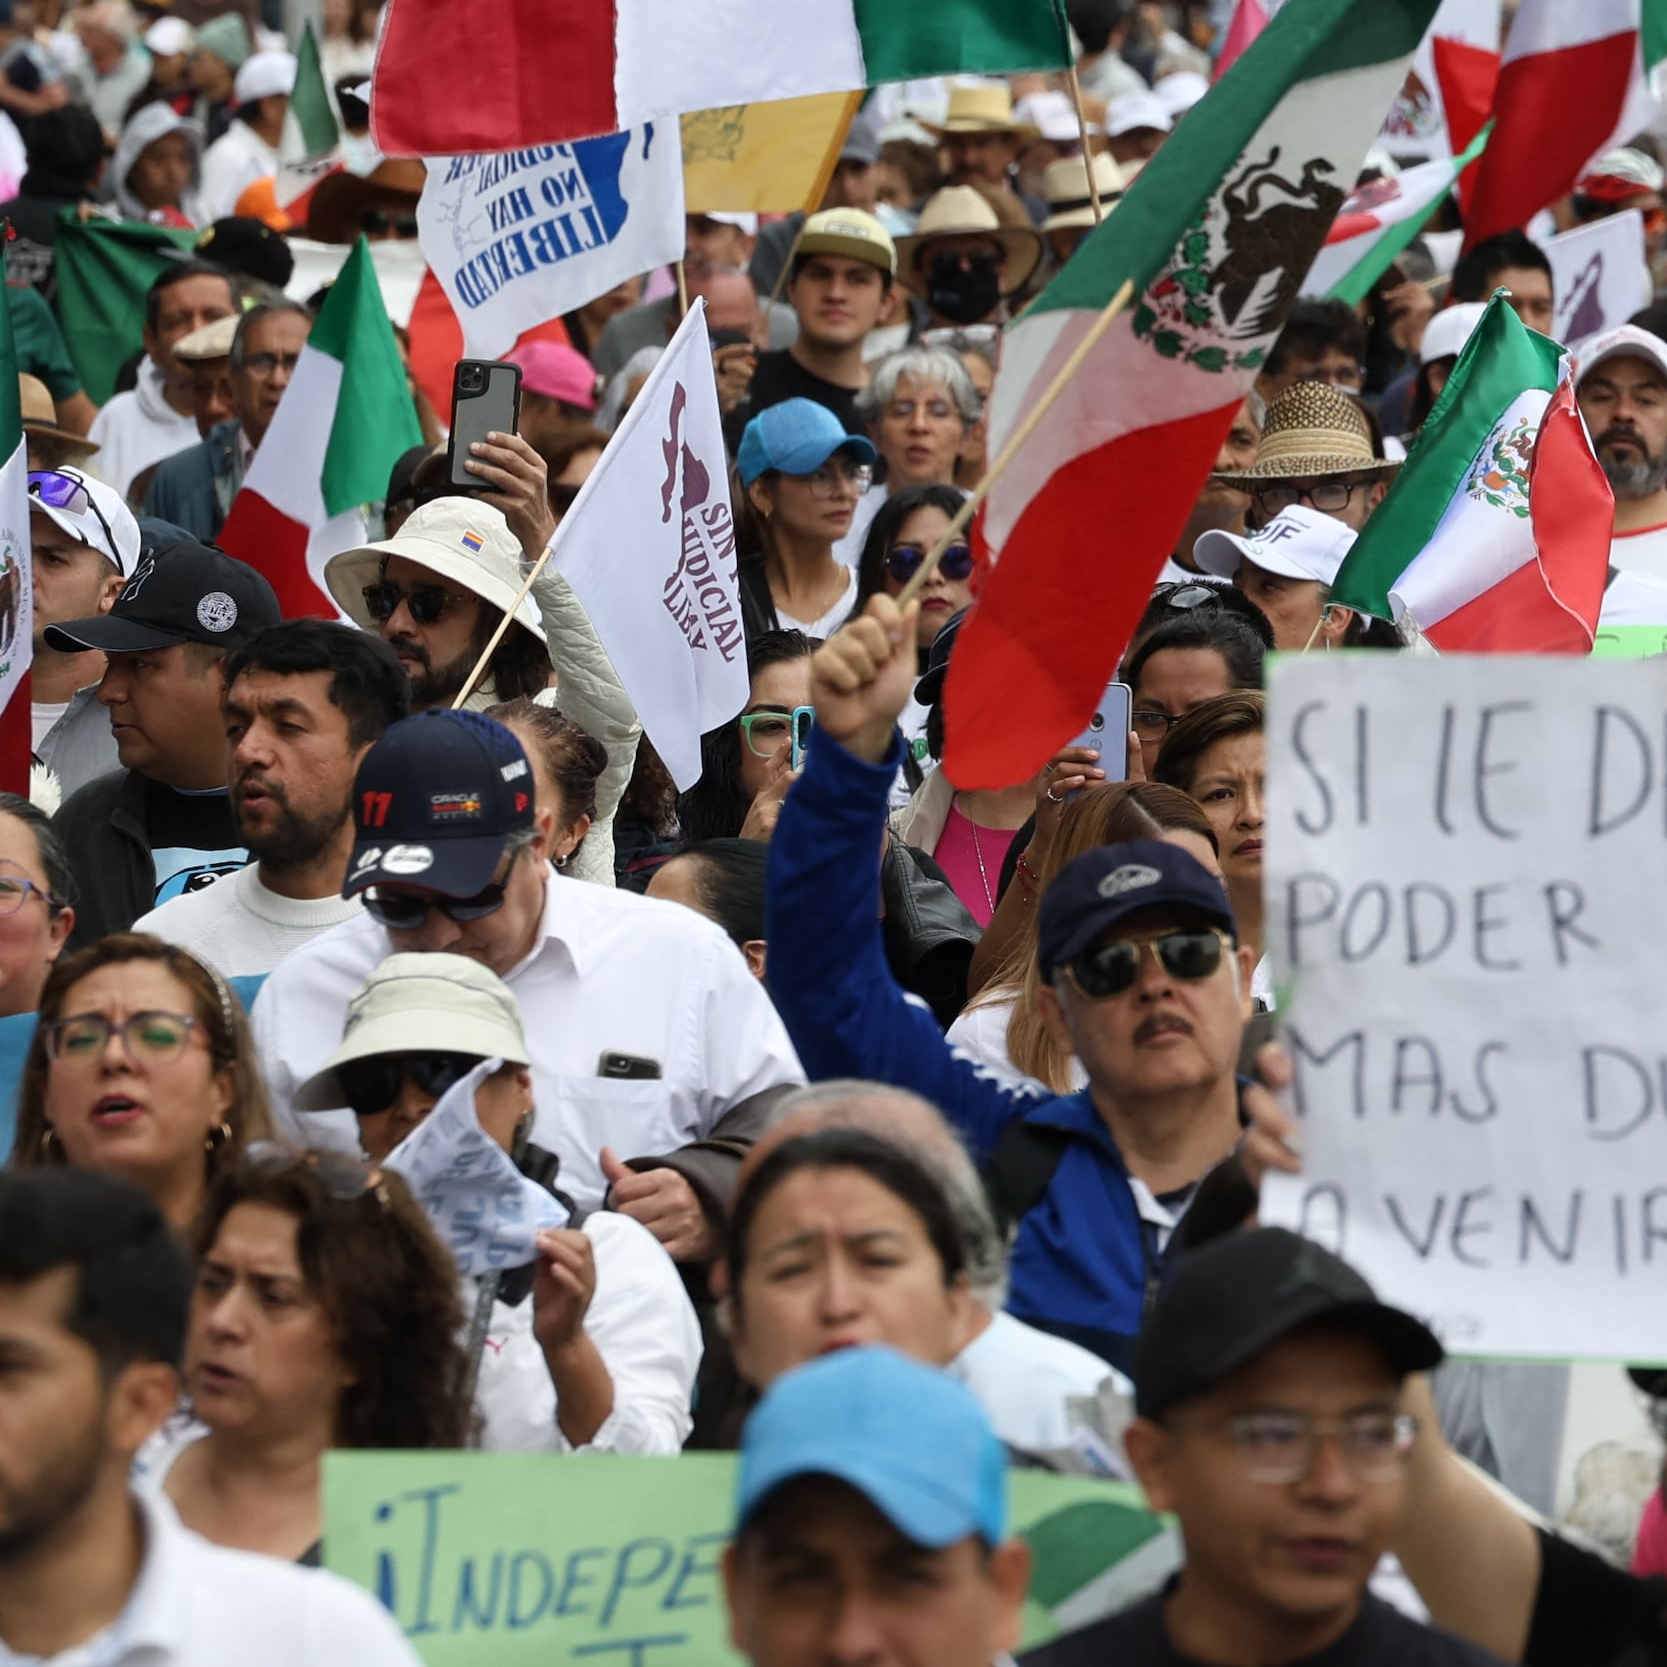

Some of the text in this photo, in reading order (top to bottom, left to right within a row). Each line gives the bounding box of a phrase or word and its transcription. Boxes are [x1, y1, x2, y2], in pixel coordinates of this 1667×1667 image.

[362, 790, 394, 827] 11
[431, 792, 480, 804] ORACLE
[1291, 700, 1369, 835] SI
[1286, 872, 1599, 971] PODER
[1286, 1028, 1508, 1123] MAS
[1302, 1181, 1346, 1254] A
[374, 1483, 735, 1638] ¡INDEPE
